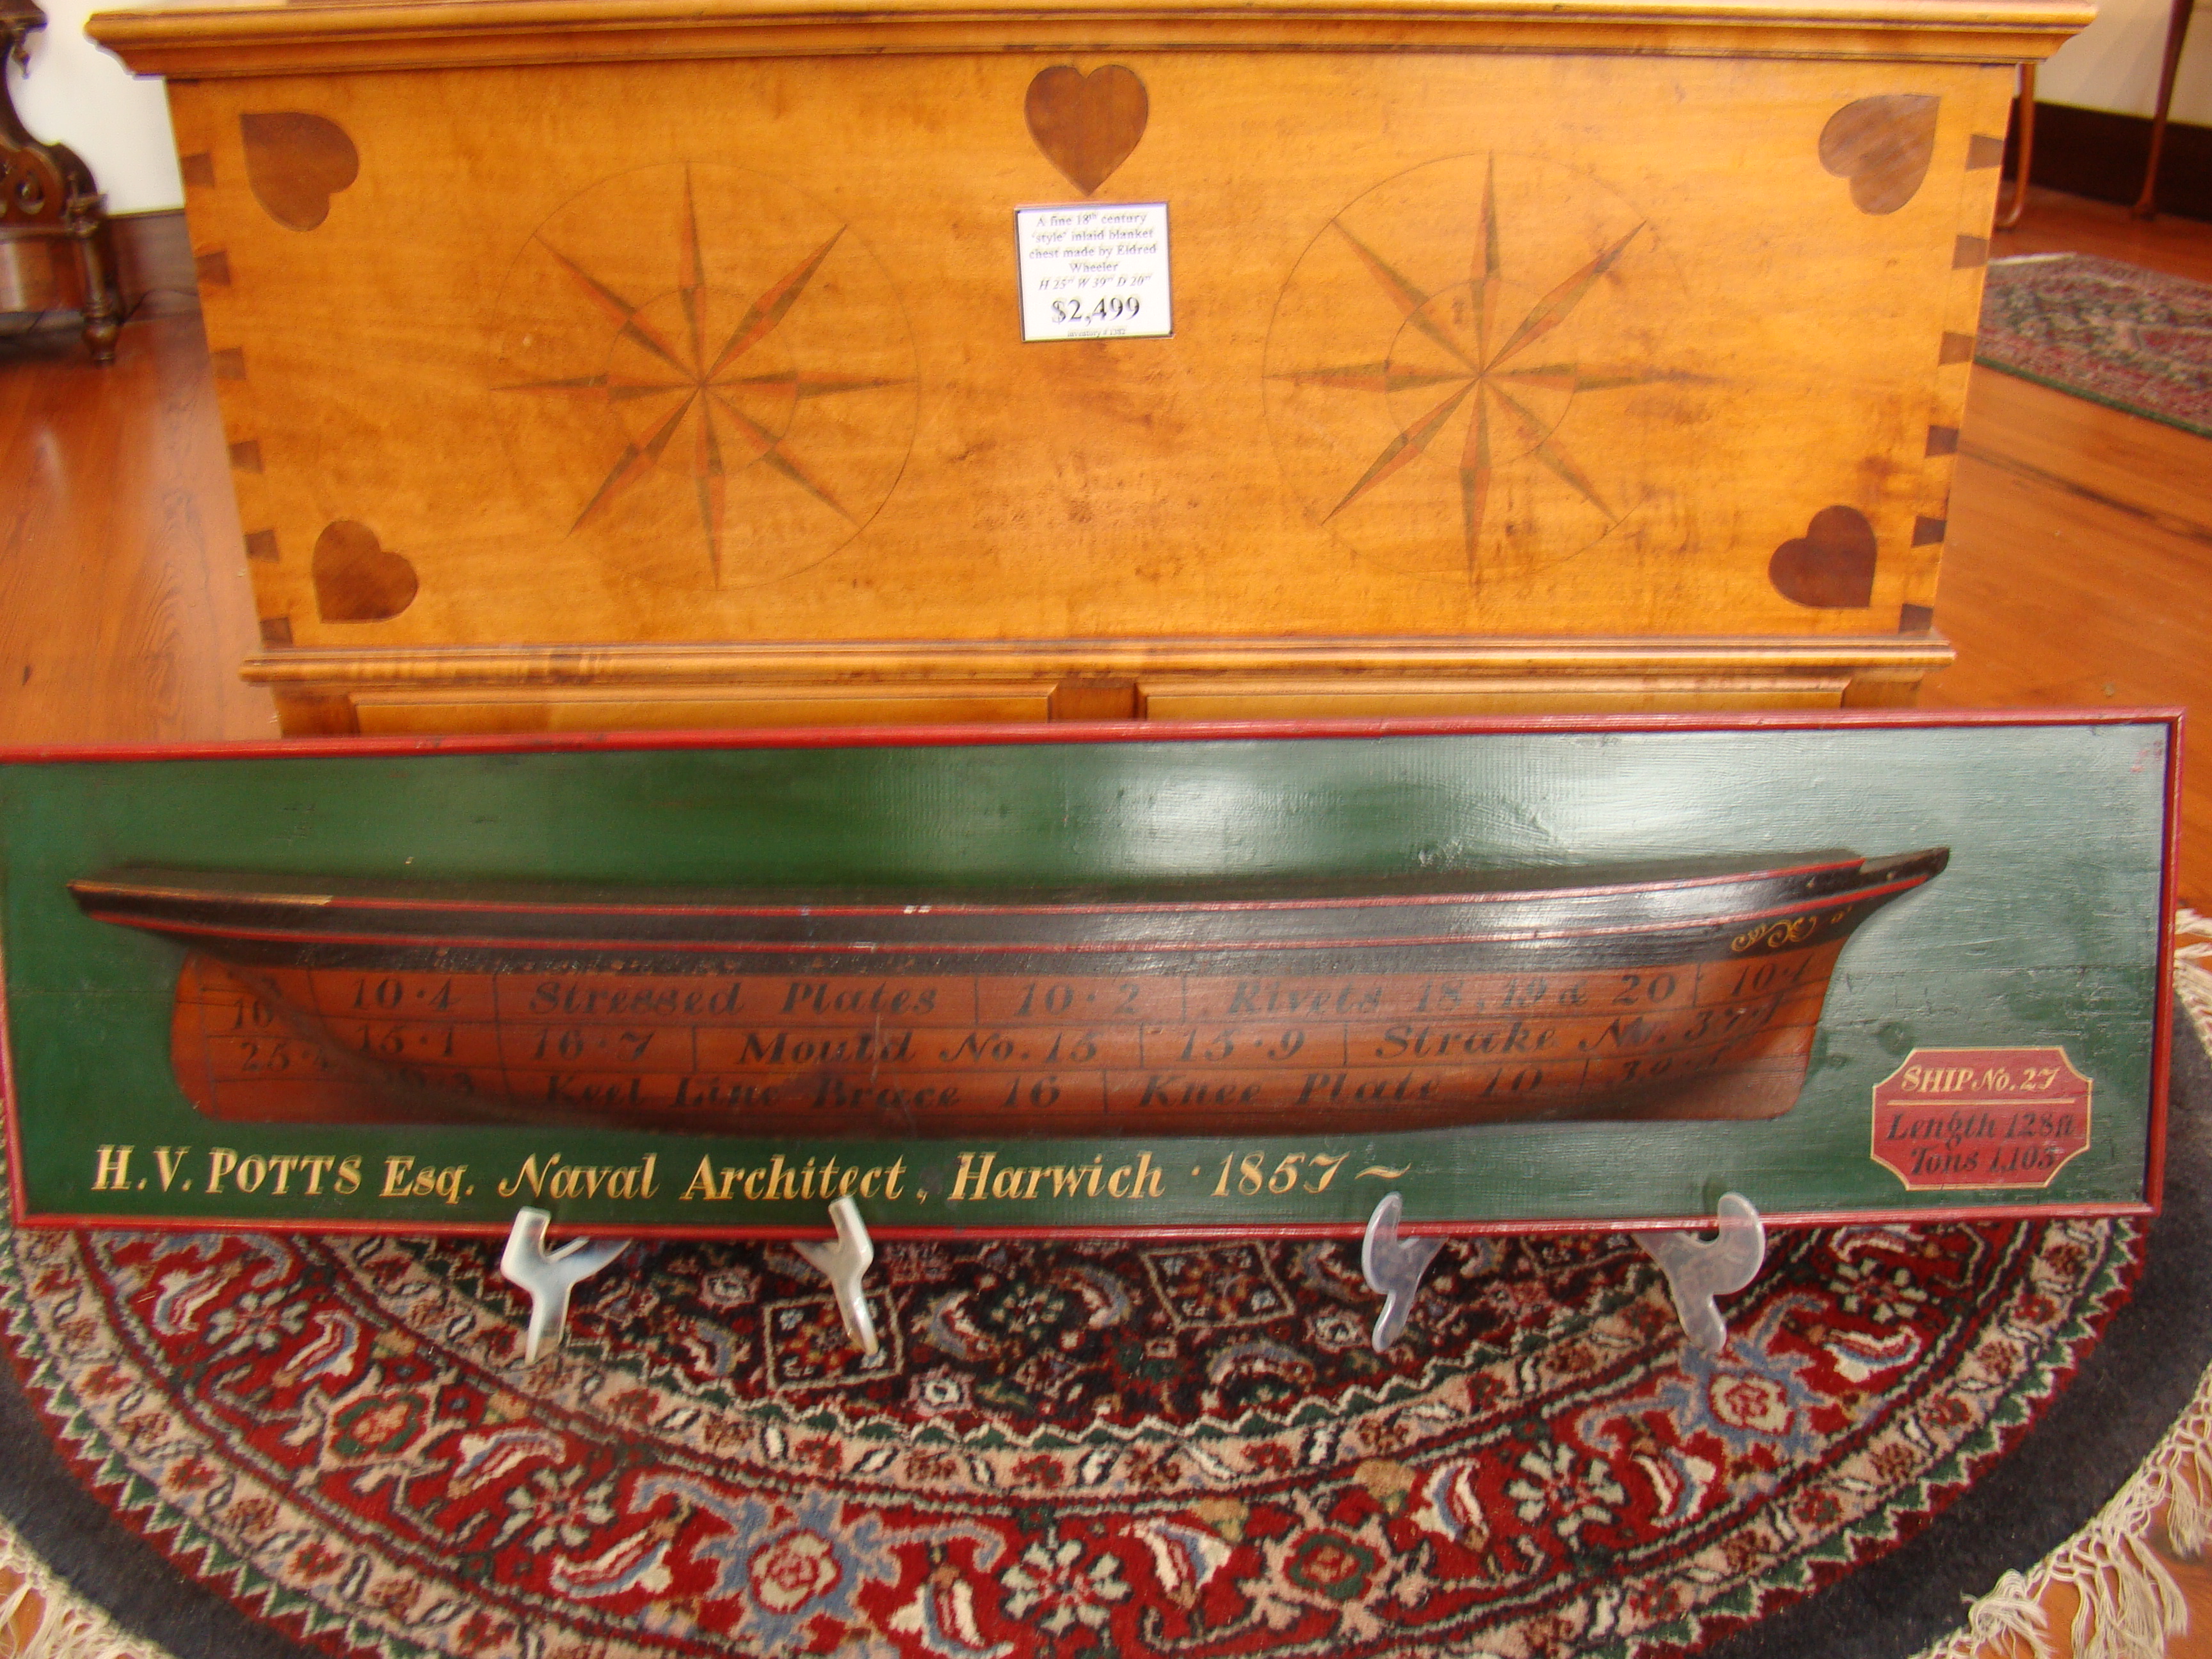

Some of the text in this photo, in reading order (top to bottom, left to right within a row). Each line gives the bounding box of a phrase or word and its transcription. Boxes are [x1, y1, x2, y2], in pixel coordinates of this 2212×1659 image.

[1036, 213, 1148, 227] A fine 18th century
[1071, 230, 1105, 242] inlaid
[1109, 228, 1154, 240] blanket
[1029, 243, 1157, 259] chest made by Eldred
[1038, 278, 1050, 291] H
[1077, 276, 1090, 289] W
[1116, 275, 1126, 287] D
[1069, 262, 1119, 274] Wheeler
[1051, 296, 1141, 326] $2,499
[1067, 329, 1102, 338] inventory
[528, 980, 744, 1016] Stressed
[780, 979, 938, 1016] Plates
[1225, 979, 1382, 1018] Rivets
[1612, 973, 1677, 1007] 20
[737, 1029, 915, 1065] Mould
[1045, 1029, 1102, 1063] 15
[1375, 1020, 1557, 1059] Strake
[1002, 1074, 1061, 1109] 16
[1138, 1071, 1263, 1109] Knee
[1295, 1071, 1442, 1106] Plate
[1479, 1067, 1544, 1098] 10
[1900, 1064, 1975, 1094] SHIP
[2021, 1065, 2062, 1092] 27
[1886, 1110, 1996, 1151] Length
[1911, 1144, 1979, 1176] Tons
[205, 1146, 363, 1196] POTTS
[379, 1154, 474, 1205] Esq.
[497, 1151, 661, 1199] Naval
[947, 1150, 1166, 1201] Harwich
[1210, 1149, 1350, 1197] 1857
